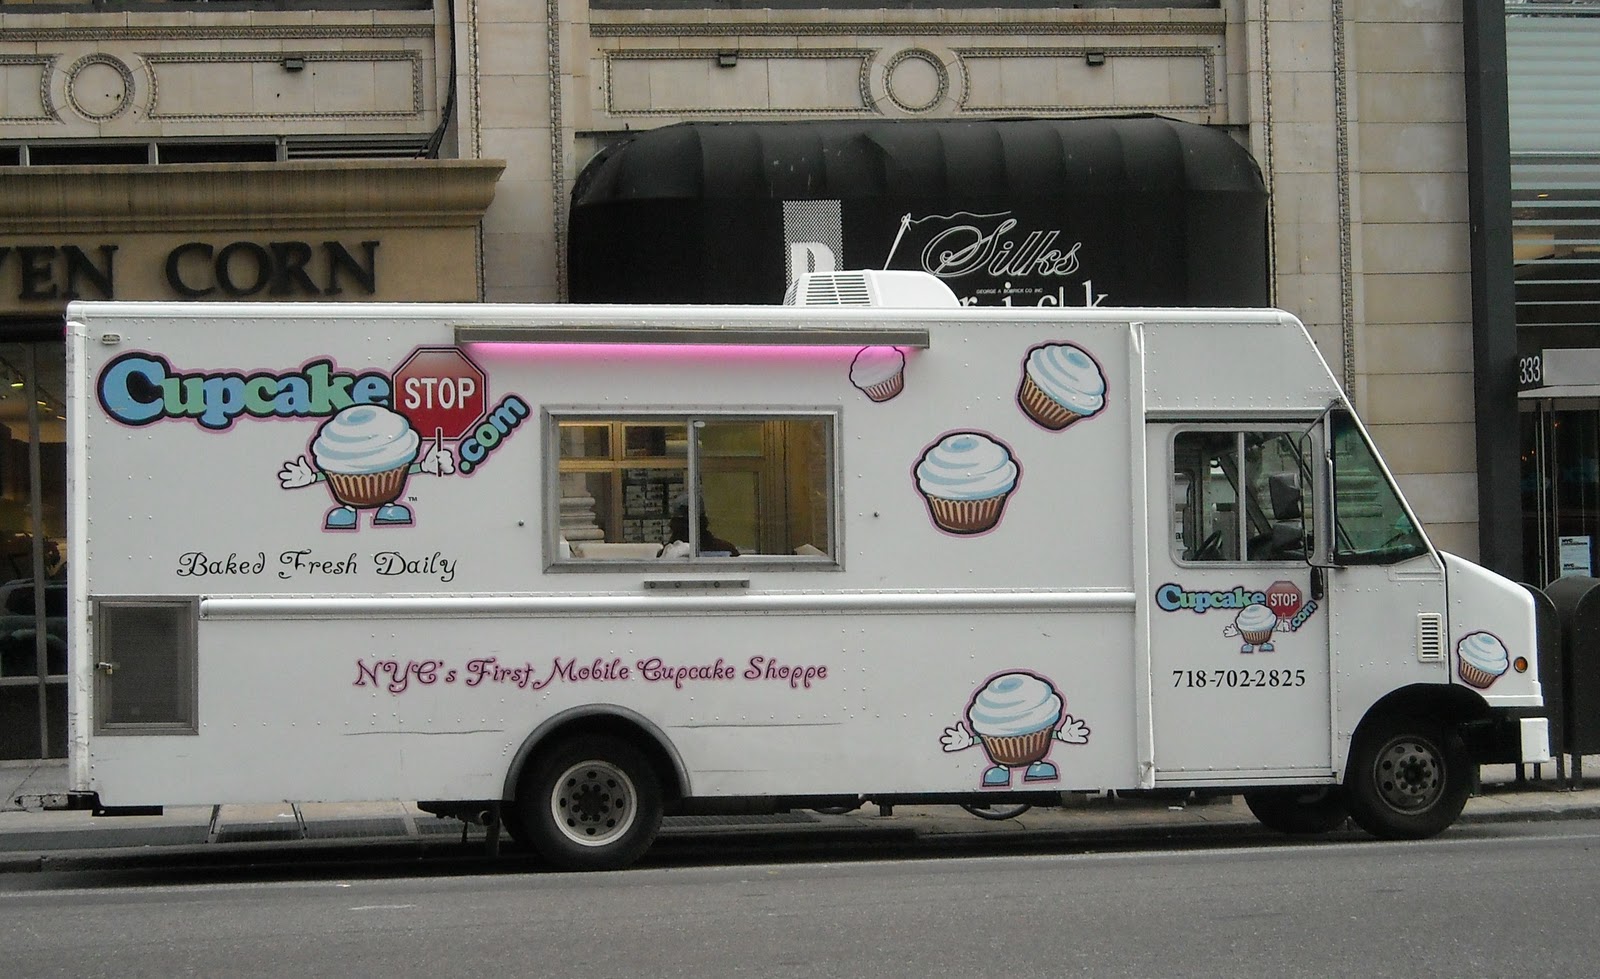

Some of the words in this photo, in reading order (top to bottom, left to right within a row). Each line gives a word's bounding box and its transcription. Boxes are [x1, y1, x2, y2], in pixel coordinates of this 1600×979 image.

[165, 241, 380, 297] CORN
[921, 218, 1082, 277] Silks
[1519, 356, 1540, 384] 333
[99, 351, 392, 428] Cupcake
[404, 377, 476, 409] STOP
[459, 394, 530, 474] .com
[176, 551, 266, 577] Baked
[278, 548, 358, 579] Fresh
[373, 551, 457, 583] Daily
[1155, 583, 1267, 613] Cupcake
[1270, 593, 1298, 607] STOP
[1291, 600, 1319, 632] .com
[352, 658, 457, 694] NYC's
[464, 656, 535, 689] First
[532, 656, 630, 690] Mobile
[636, 657, 736, 690] Cupcake
[743, 655, 828, 690] Shoppe
[1172, 669, 1306, 688] 718-702-2825
